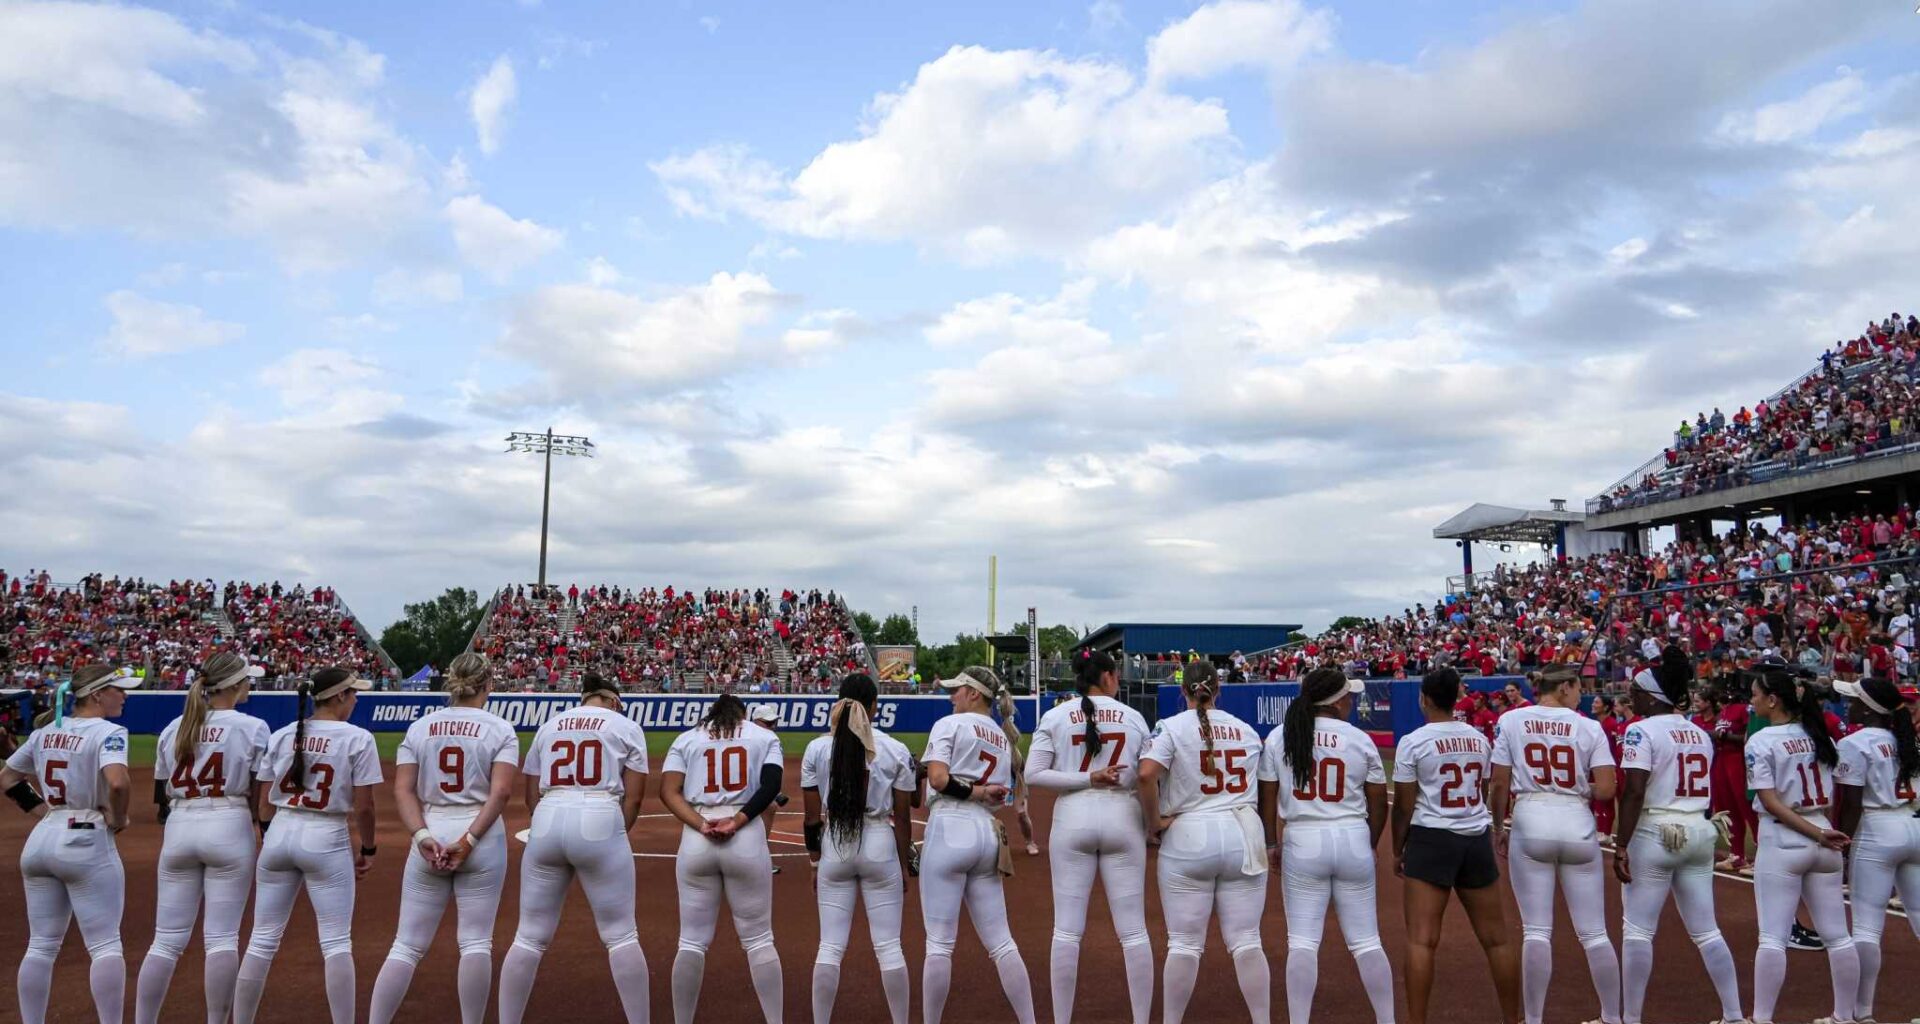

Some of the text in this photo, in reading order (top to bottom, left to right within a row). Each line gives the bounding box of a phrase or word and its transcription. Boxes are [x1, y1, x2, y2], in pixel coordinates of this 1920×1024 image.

[373, 705, 420, 721] HOME
[557, 717, 606, 732] STEWART
[1070, 709, 1124, 724] GUERREZ
[1257, 689, 1295, 725] OKLAHO
[43, 733, 84, 752] BENNETT
[200, 727, 224, 743] USZ
[429, 720, 481, 738] MITCHELL
[973, 724, 1008, 751] MALONEY
[1315, 732, 1338, 748] LLS
[1435, 737, 1483, 754] MARTINEZ
[1524, 720, 1572, 737] SIMPSON
[1782, 737, 1816, 756] BRISTE
[439, 746, 465, 793] 9
[550, 739, 602, 787] 20
[703, 745, 748, 794] 10
[974, 750, 997, 785] 7
[1071, 732, 1126, 772] 77
[1523, 742, 1577, 789] 99
[44, 760, 68, 806] 5
[171, 751, 227, 798] 44
[279, 762, 335, 810] 43
[1199, 748, 1248, 795] 55
[1439, 761, 1483, 808] 23
[1675, 752, 1709, 797] 12
[1796, 761, 1829, 807] 11
